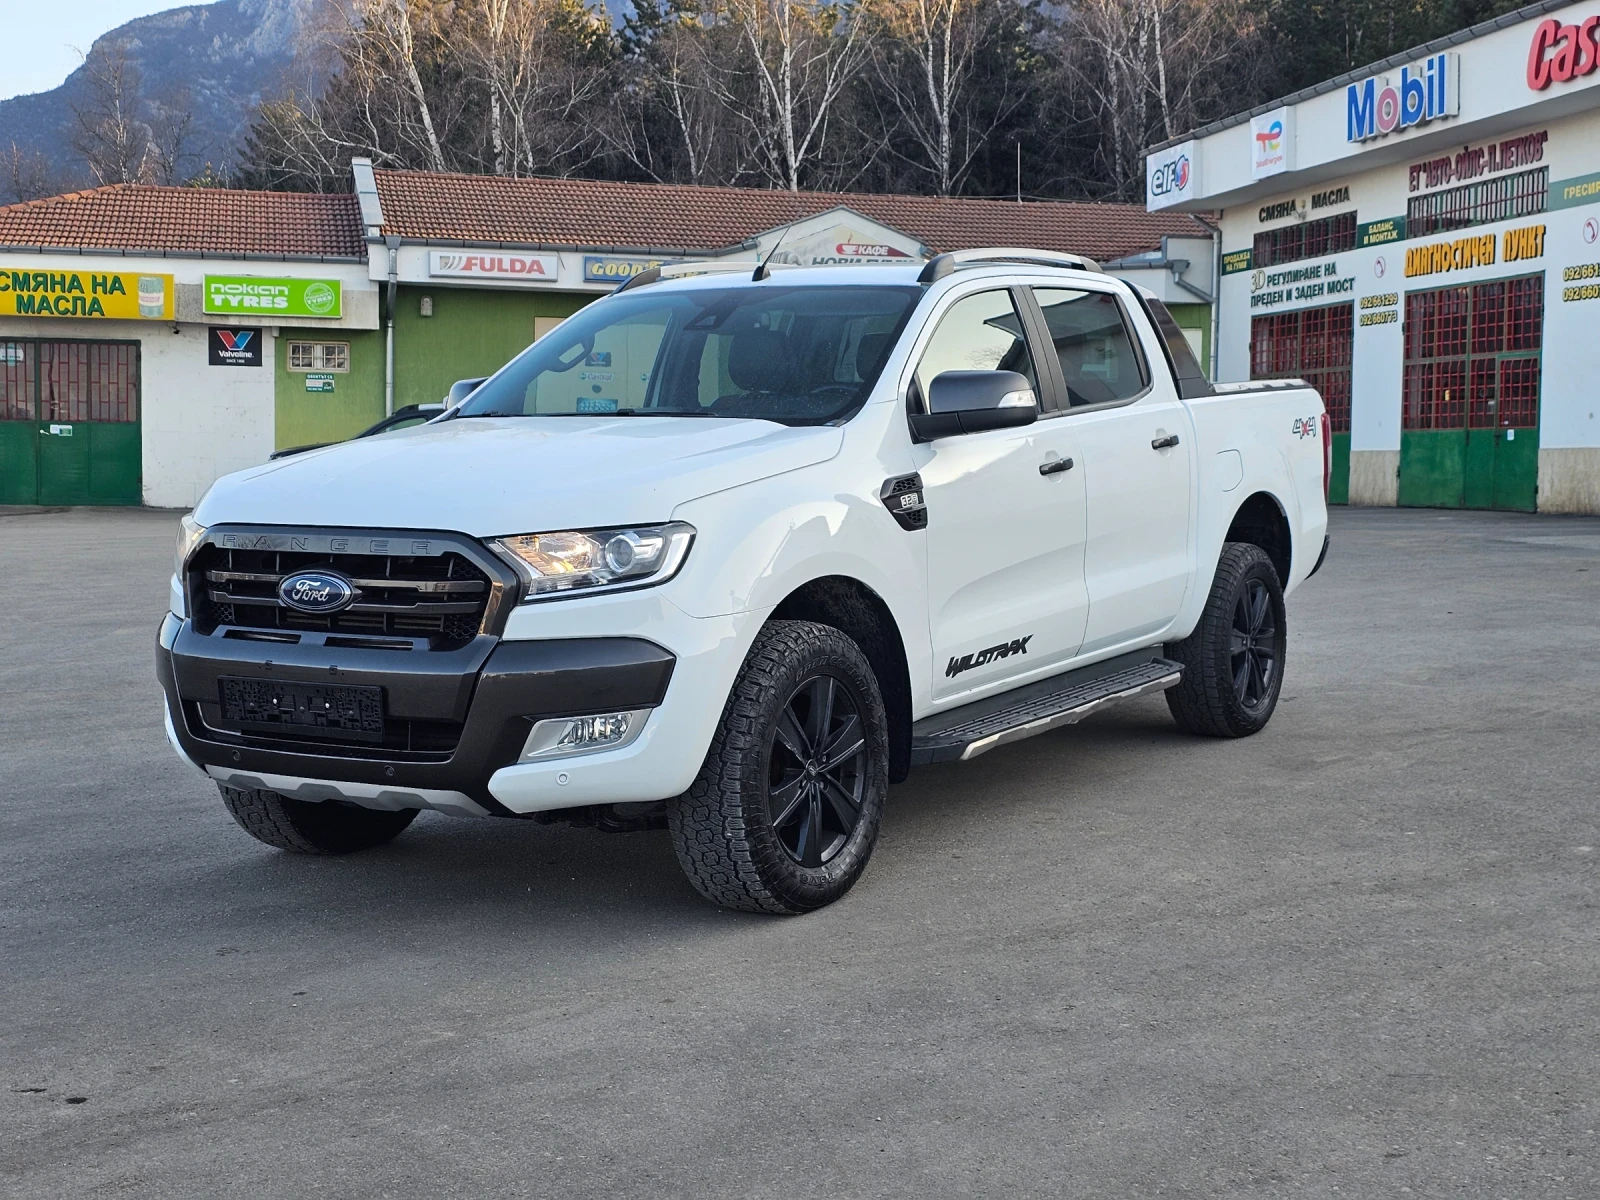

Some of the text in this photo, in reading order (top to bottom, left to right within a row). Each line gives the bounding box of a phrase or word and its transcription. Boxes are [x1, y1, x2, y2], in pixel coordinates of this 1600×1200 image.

[1526, 16, 1600, 91] Cas
[1347, 53, 1449, 142] Mobil
[1151, 160, 1176, 196] elf
[1409, 163, 1421, 192] ЕТ
[1259, 185, 1351, 223] СМЯНА МАСЛА
[1368, 221, 1394, 234] БАЛАНС
[1369, 230, 1398, 244] МОНТАЖ
[858, 245, 889, 256] КАФЕ
[1404, 224, 1547, 278] ДИАГНОСТИЧЕН ПУНКТ
[460, 255, 545, 275] FULDA
[1562, 263, 1600, 282] 092/661
[0, 271, 127, 296] СМЯНА НА
[1250, 261, 1337, 294] 3D РЕГУЛИРАНЕ НА
[211, 294, 289, 309] TYRES
[1250, 276, 1356, 308] ПРЕДЕН И ЗАДЕН МОСТ
[1562, 284, 1600, 302] 092/660
[16, 294, 105, 317] МАСЛА
[218, 350, 253, 359] Valvoline
[223, 534, 431, 554] RANGER
[292, 580, 330, 602] Ford
[945, 633, 1034, 678] WILDTRAK
